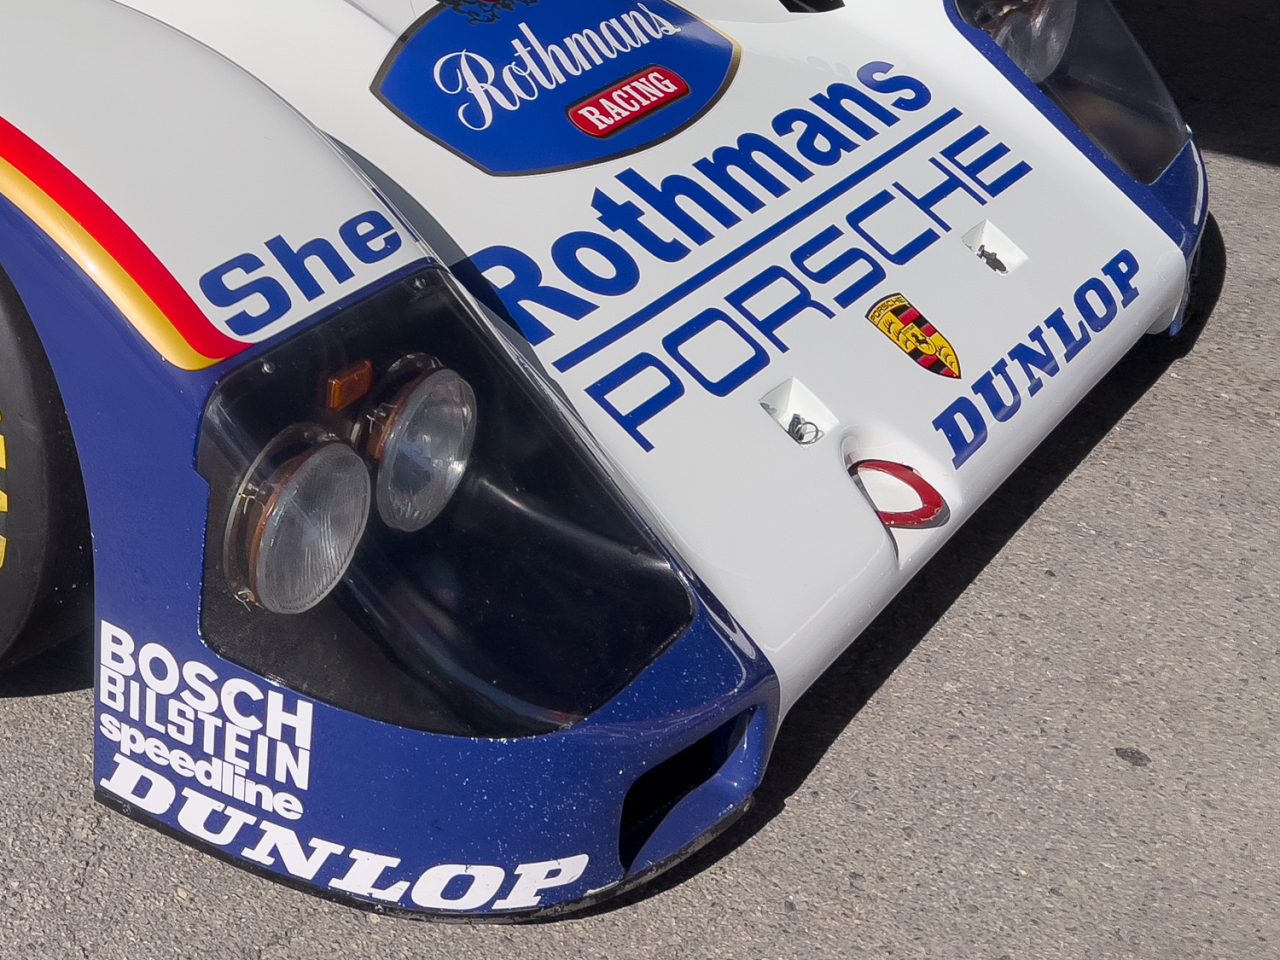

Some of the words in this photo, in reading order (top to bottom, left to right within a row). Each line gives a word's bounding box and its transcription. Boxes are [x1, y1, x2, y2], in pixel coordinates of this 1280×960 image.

[433, 2, 682, 131] Rothmans
[577, 70, 679, 131] RACING
[448, 59, 932, 347] Rothmans
[584, 124, 1034, 453] PORSCHE
[870, 296, 906, 322] PORSCHE
[931, 248, 1144, 469] DUNLOP
[100, 664, 311, 791] BILSTEIN
[101, 620, 314, 750] BOSCH
[99, 712, 304, 820] speedline
[99, 753, 590, 911] DUNLOP
